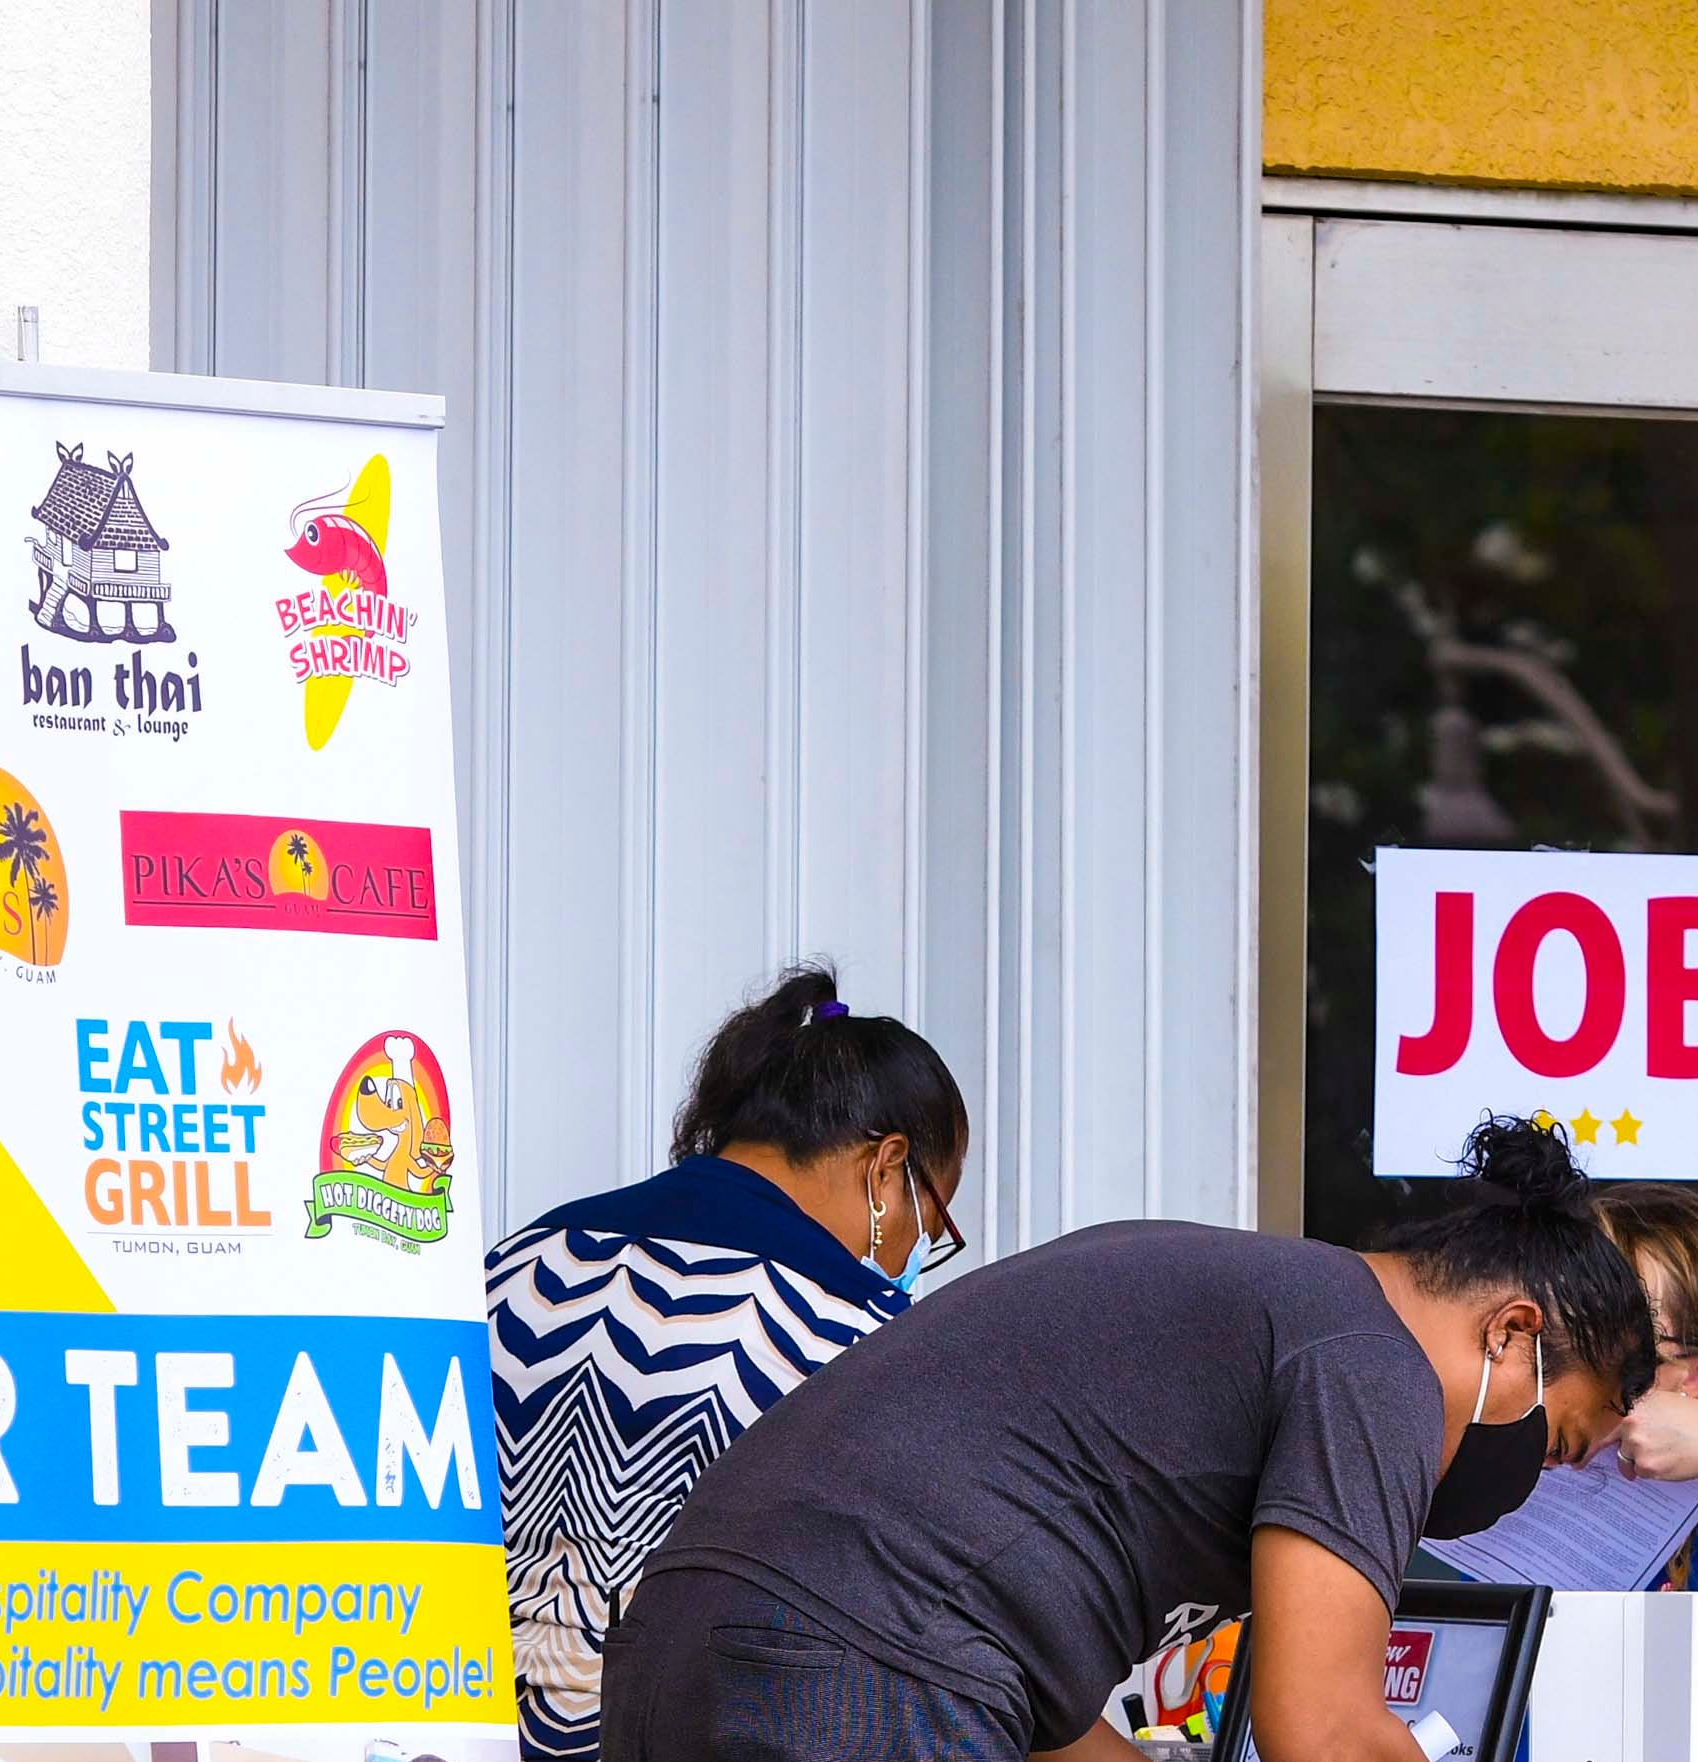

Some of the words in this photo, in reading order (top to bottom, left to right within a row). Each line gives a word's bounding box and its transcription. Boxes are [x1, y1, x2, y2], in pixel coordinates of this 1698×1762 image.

[274, 590, 419, 641] BEACHIN'
[21, 643, 93, 709] ban
[114, 649, 202, 717] thai
[288, 638, 410, 685] SHRIMP
[32, 713, 107, 732] restaurant
[137, 713, 189, 742] lounge
[131, 854, 267, 900] PIKA'S
[330, 863, 430, 910] CAFE
[15, 965, 57, 985] GUAM
[76, 1018, 213, 1096] EAT
[81, 1100, 266, 1154] STREET
[84, 1157, 272, 1227] GRILL
[320, 1181, 354, 1209] HOT
[356, 1185, 415, 1230] DIGGETY
[415, 1206, 442, 1232] DOG
[112, 1240, 180, 1256] TUMON,
[186, 1241, 242, 1255] GUAM
[64, 1349, 483, 1512] TEAM
[166, 1570, 423, 1636] Company
[138, 1658, 312, 1701] means
[328, 1644, 494, 1711] People!
